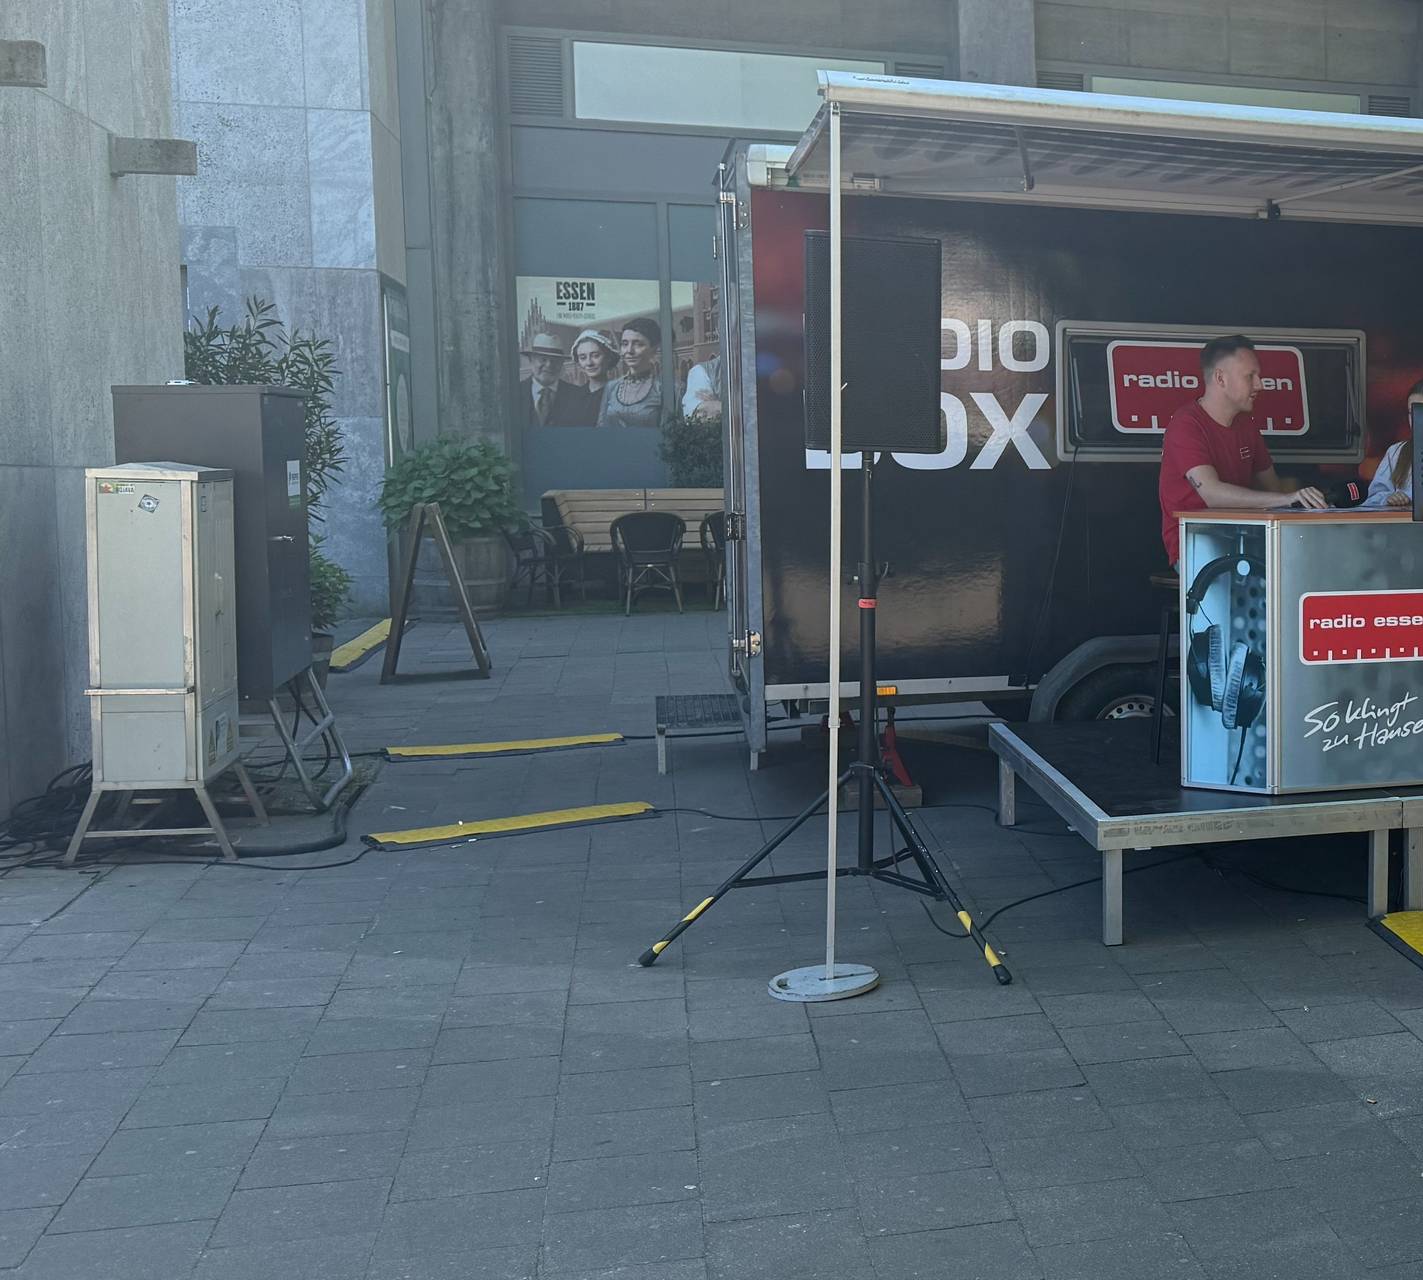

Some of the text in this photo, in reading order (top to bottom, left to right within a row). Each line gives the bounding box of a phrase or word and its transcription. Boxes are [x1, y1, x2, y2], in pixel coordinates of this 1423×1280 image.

[556, 281, 595, 300] ESSEN
[941, 318, 1050, 372] DIO
[1123, 371, 1199, 389] radio
[1309, 614, 1365, 630] radio
[1303, 691, 1419, 738] So klingt
[1322, 734, 1349, 752] zu
